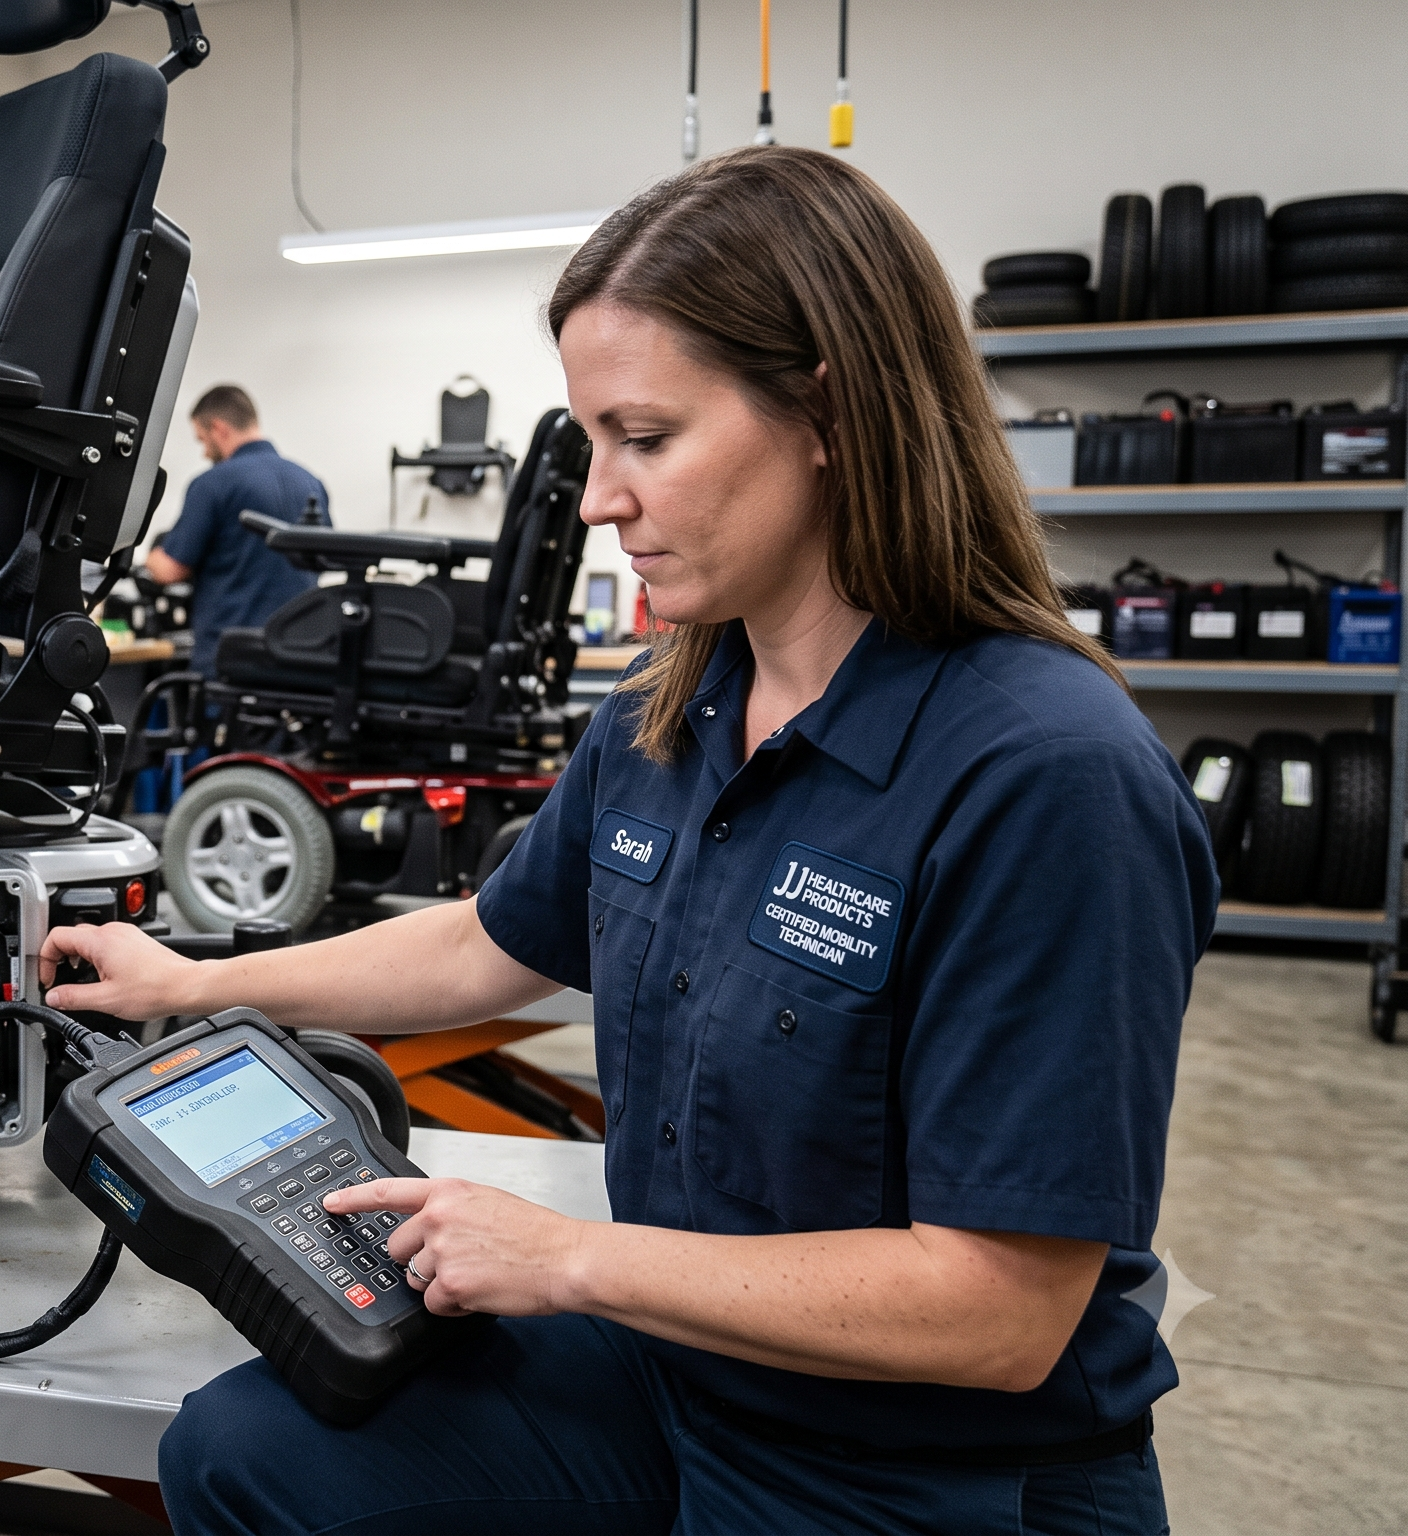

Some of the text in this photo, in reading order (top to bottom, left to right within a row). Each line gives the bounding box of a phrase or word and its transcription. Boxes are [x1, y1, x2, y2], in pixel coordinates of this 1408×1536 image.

[611, 829, 653, 863] Sarah
[773, 861, 892, 917] JJ HEALTHCARE
[801, 888, 874, 929] PRODUCTS
[765, 902, 879, 959] CERTIFIED MOBILITY
[778, 925, 846, 966] TECHNICIAN
